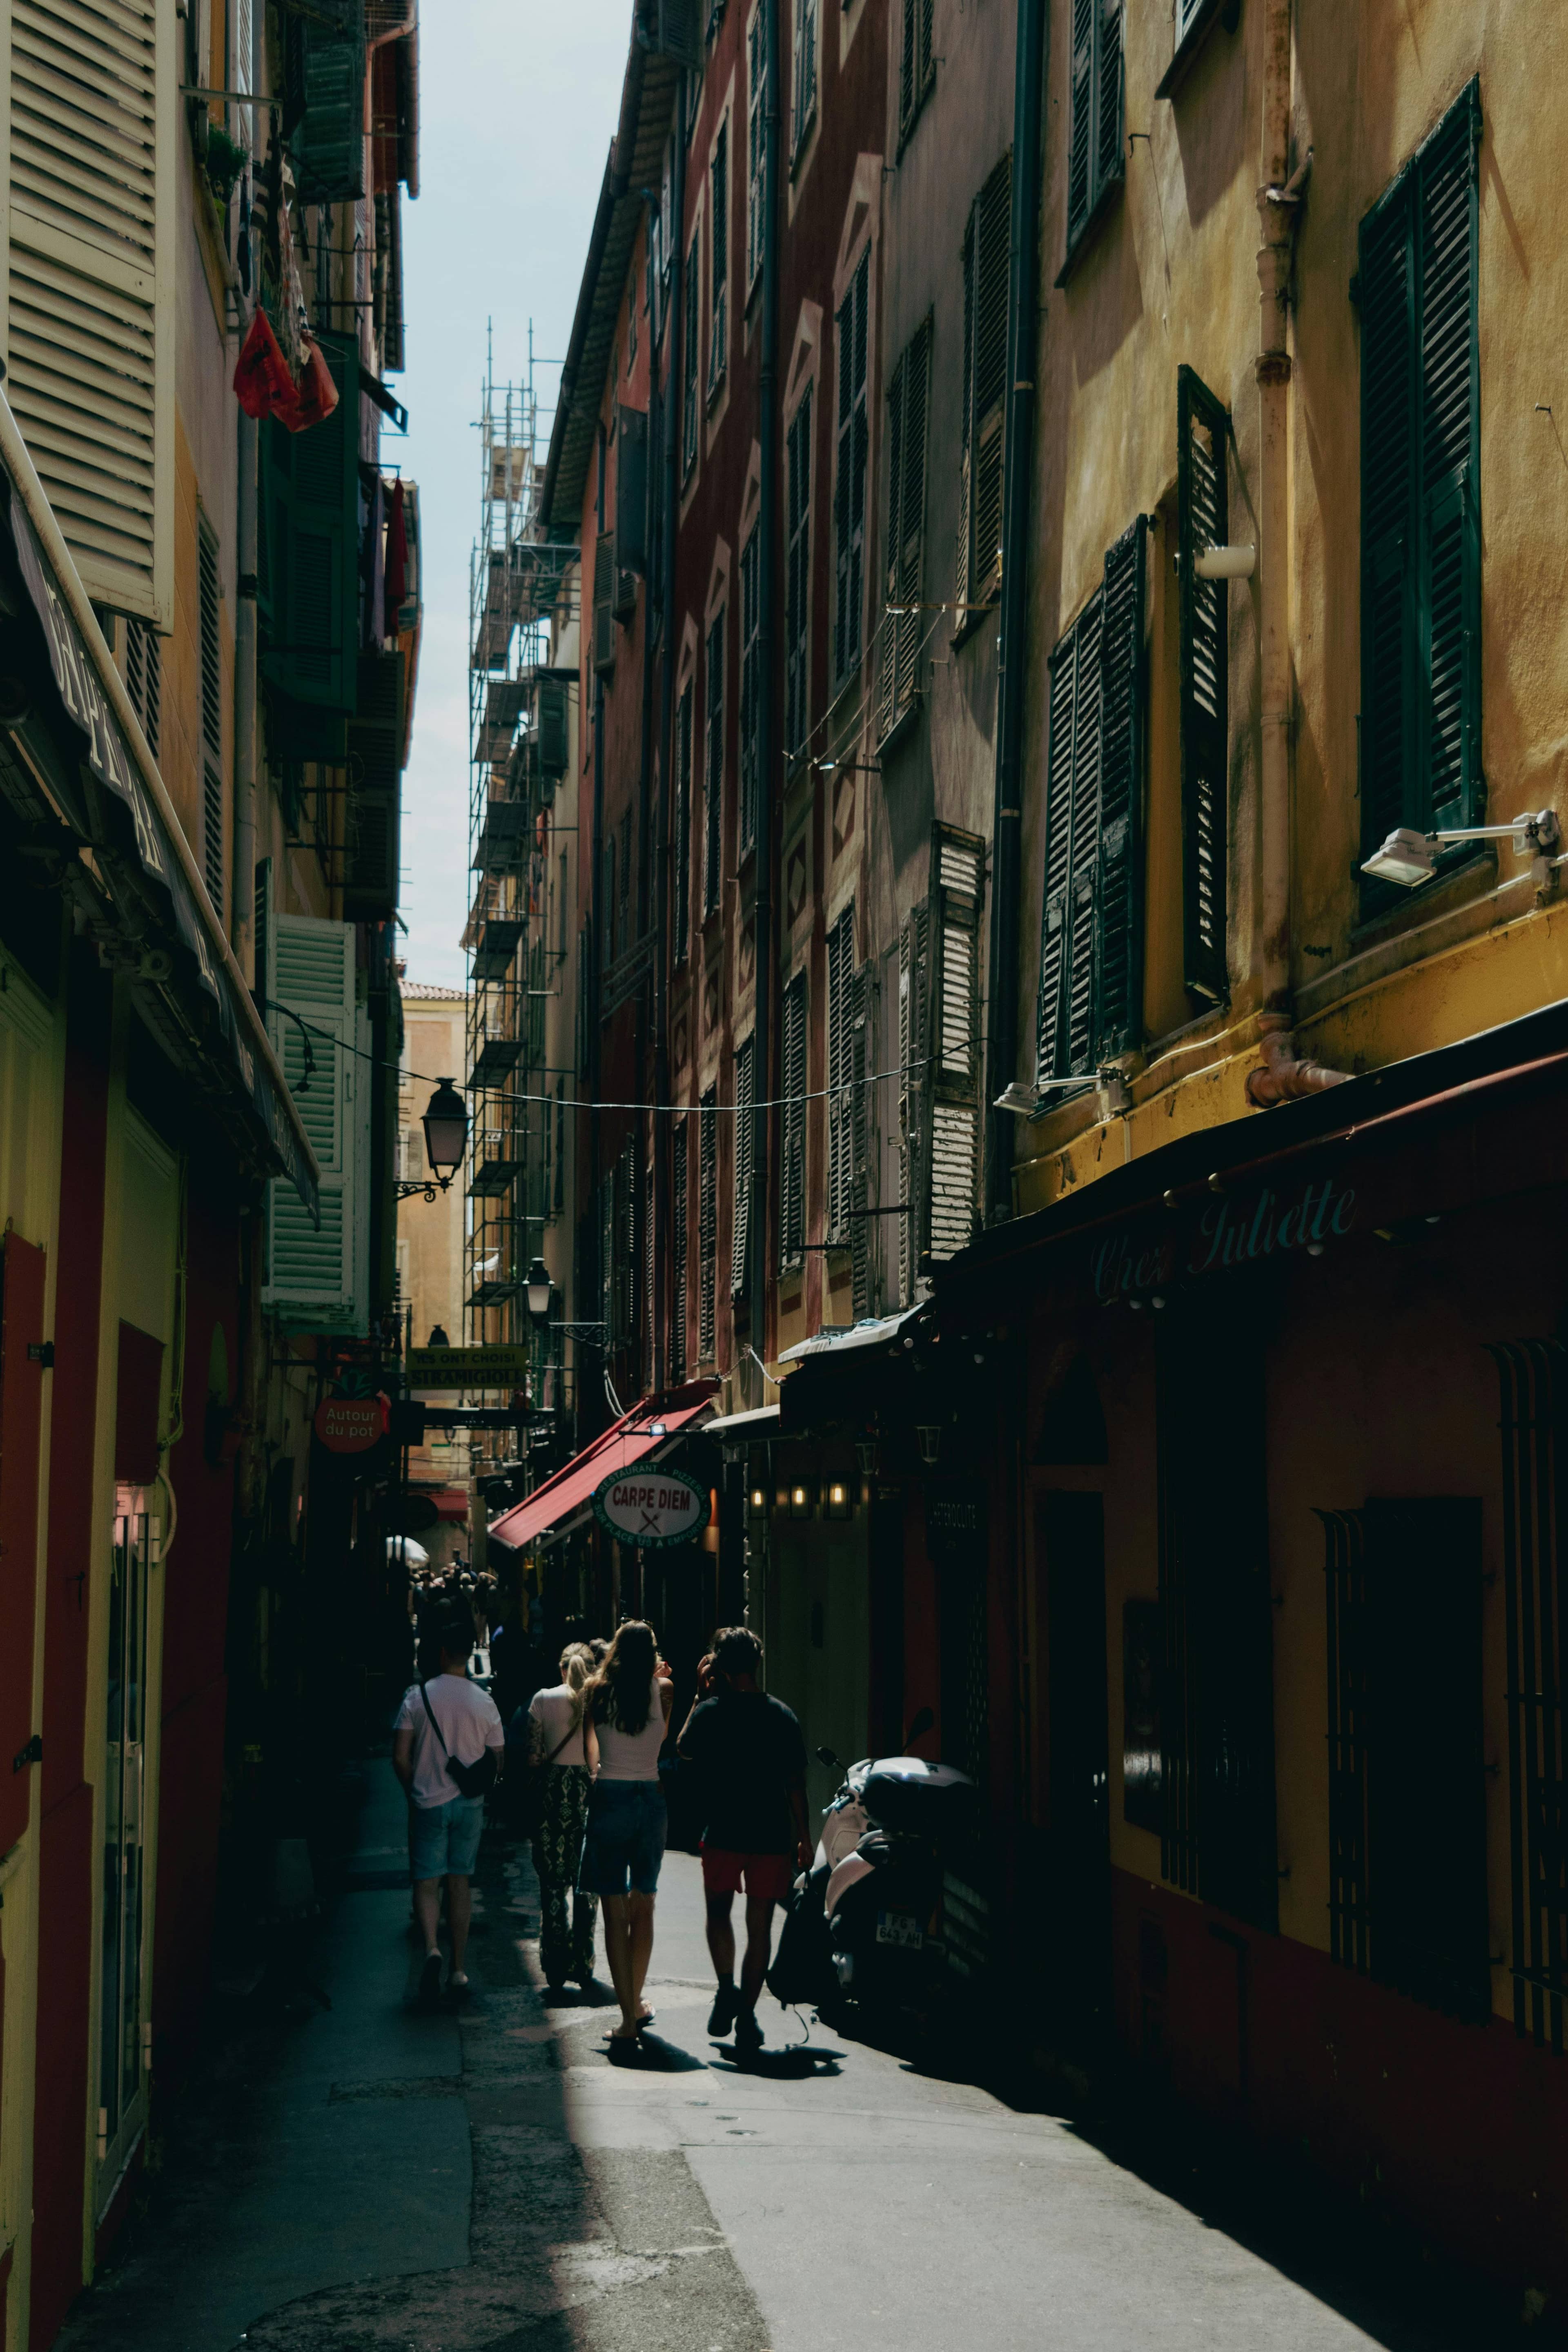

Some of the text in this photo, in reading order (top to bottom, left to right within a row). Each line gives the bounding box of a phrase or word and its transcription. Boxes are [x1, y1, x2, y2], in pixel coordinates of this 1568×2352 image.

[1091, 1179, 1360, 1298] Chez Juliette
[441, 1354, 466, 1363] ONT
[472, 1353, 515, 1363] CHOISI
[327, 1408, 376, 1421] Autour
[326, 1423, 374, 1438] du pot
[599, 1464, 707, 1501] RESTAURANT PIZZERIA
[613, 1485, 690, 1511] CARPE DIEM
[595, 1504, 606, 1524] SUR
[605, 1523, 634, 1544] PLACE
[668, 1512, 710, 1546] EMPORTER
